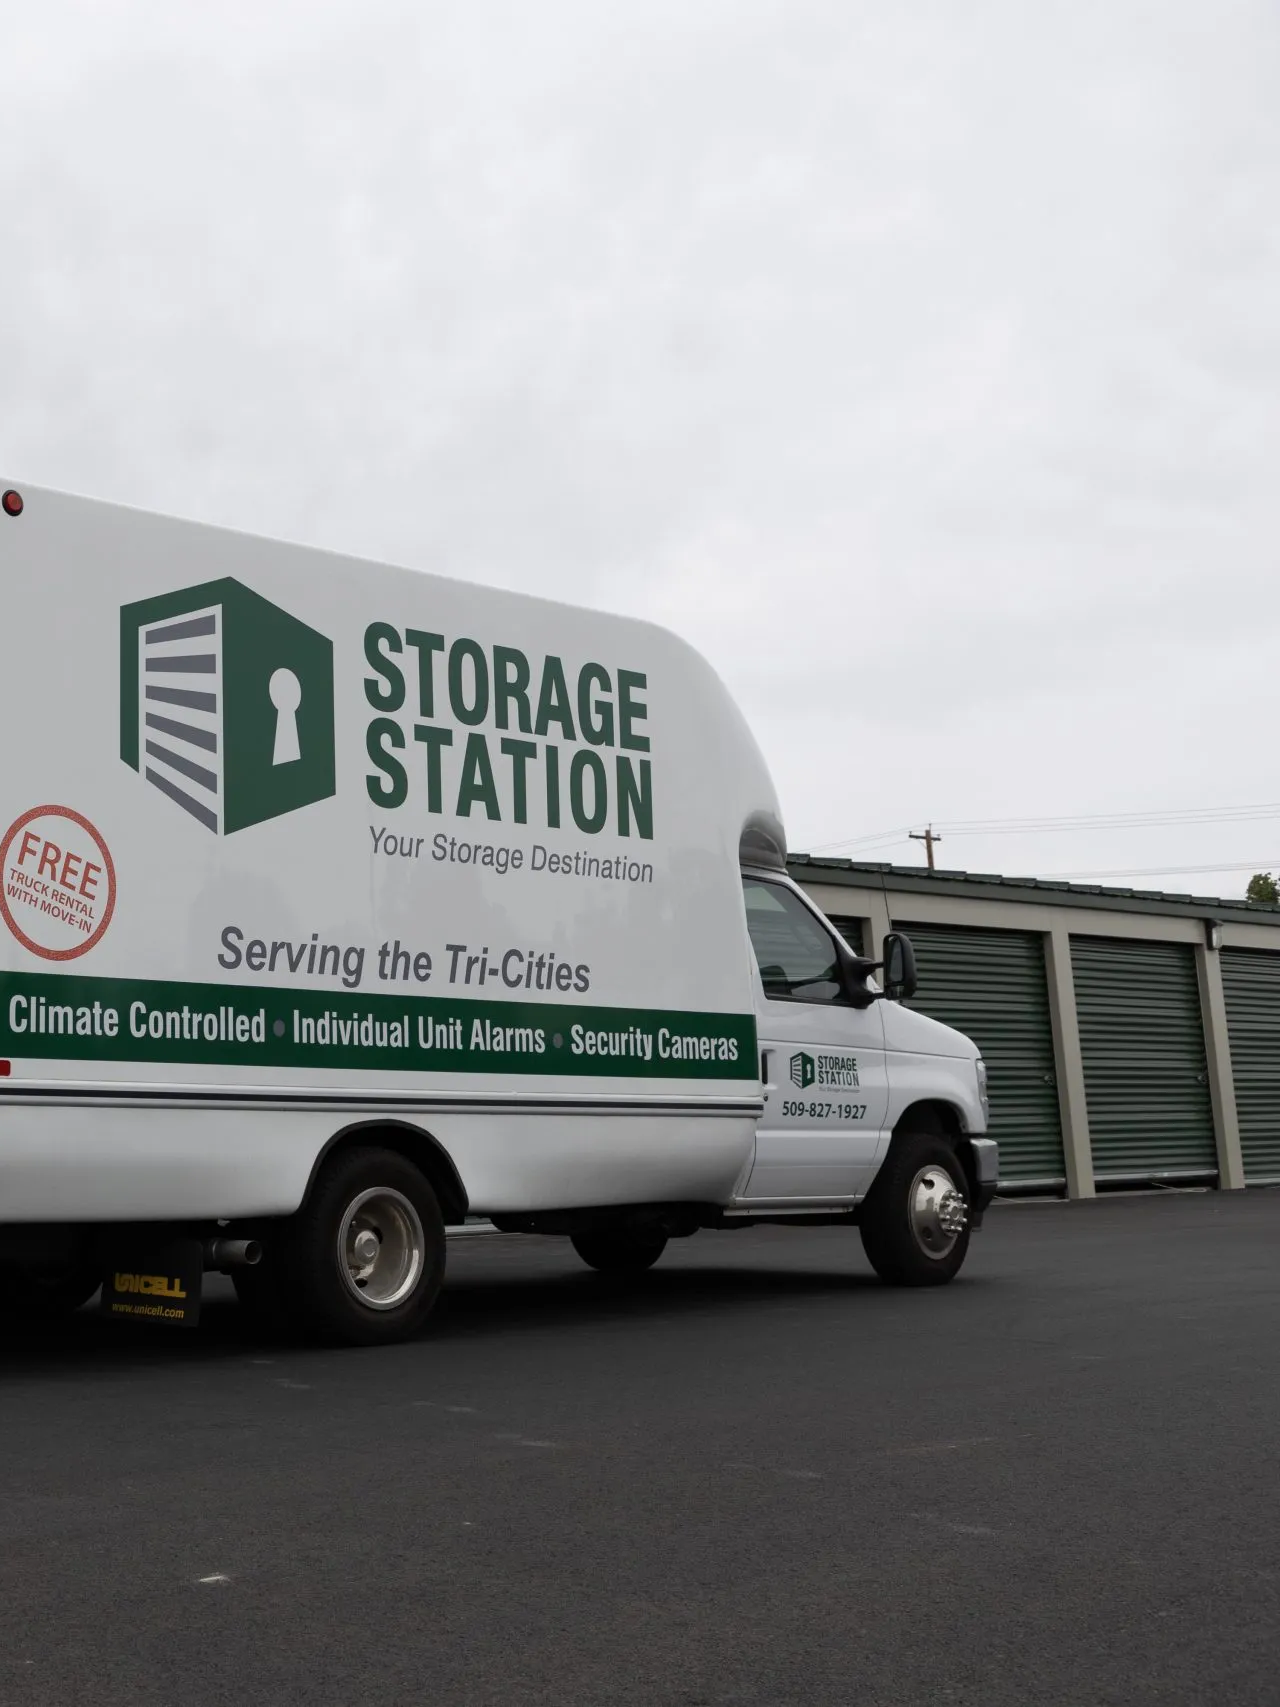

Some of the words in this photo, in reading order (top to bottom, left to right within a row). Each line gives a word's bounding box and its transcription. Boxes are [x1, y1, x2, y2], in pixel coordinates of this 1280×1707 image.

[363, 621, 651, 753] STORAGE
[365, 717, 654, 840] STATION
[17, 831, 102, 901] FREE
[369, 825, 424, 858] Your
[431, 833, 524, 875] Storage
[530, 845, 654, 883] Destination
[7, 883, 39, 908] WITH
[40, 900, 92, 933] MOVE-IN
[10, 868, 50, 897] TRUCK
[51, 888, 95, 919] RENTAL
[217, 925, 365, 989] Serving
[377, 940, 432, 982] the
[445, 943, 591, 993] Tri-Cities
[9, 994, 119, 1037] Climate
[129, 1000, 266, 1043] Controlled
[293, 1009, 410, 1048] Individual
[418, 1015, 463, 1050] Unit
[469, 1018, 546, 1053] Alarms
[570, 1024, 653, 1061] Security
[658, 1028, 739, 1061] Cameras
[818, 1055, 857, 1072] STORAGE
[818, 1070, 860, 1087] STATION
[782, 1101, 867, 1119] 509-827-1927
[114, 1272, 187, 1298] UNICELL
[112, 1303, 185, 1319] www.unicell.com
